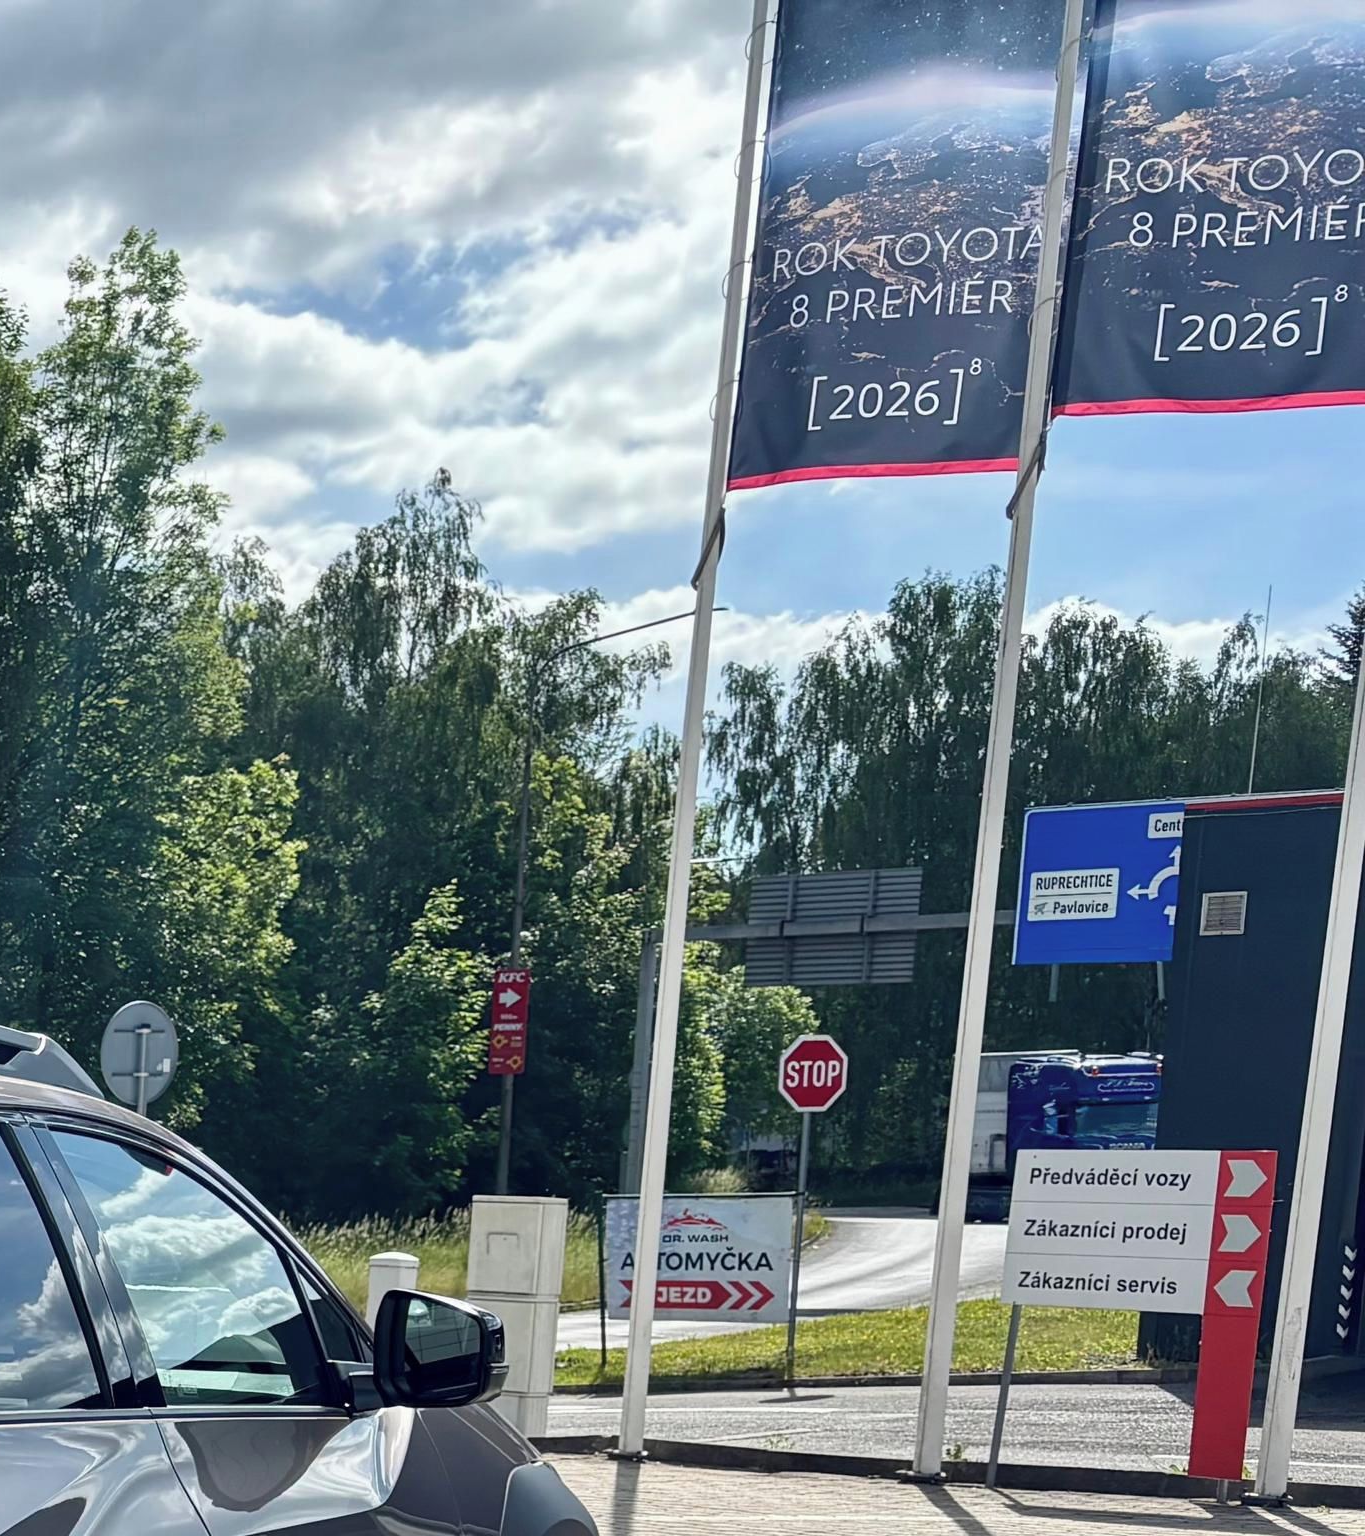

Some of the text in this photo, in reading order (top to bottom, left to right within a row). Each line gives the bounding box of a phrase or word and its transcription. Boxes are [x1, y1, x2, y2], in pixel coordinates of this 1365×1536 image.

[1105, 156, 1208, 194] ROK
[1128, 211, 1154, 248] 8
[772, 224, 1044, 283] ROK TOYOTA
[789, 271, 1015, 329] 8 PREMIÉR
[1035, 874, 1114, 891] RUPRECHTICE
[1052, 900, 1109, 915] Pavlovice
[498, 972, 526, 983] KFC
[785, 1059, 842, 1089] STOP
[1029, 1167, 1192, 1191] Předváděcí vozy
[687, 1234, 729, 1243] WASH
[1024, 1219, 1187, 1246] Zákazníci prodej
[620, 1246, 774, 1272] ATOMYČKA
[1017, 1270, 1178, 1295] Zákazníci servis
